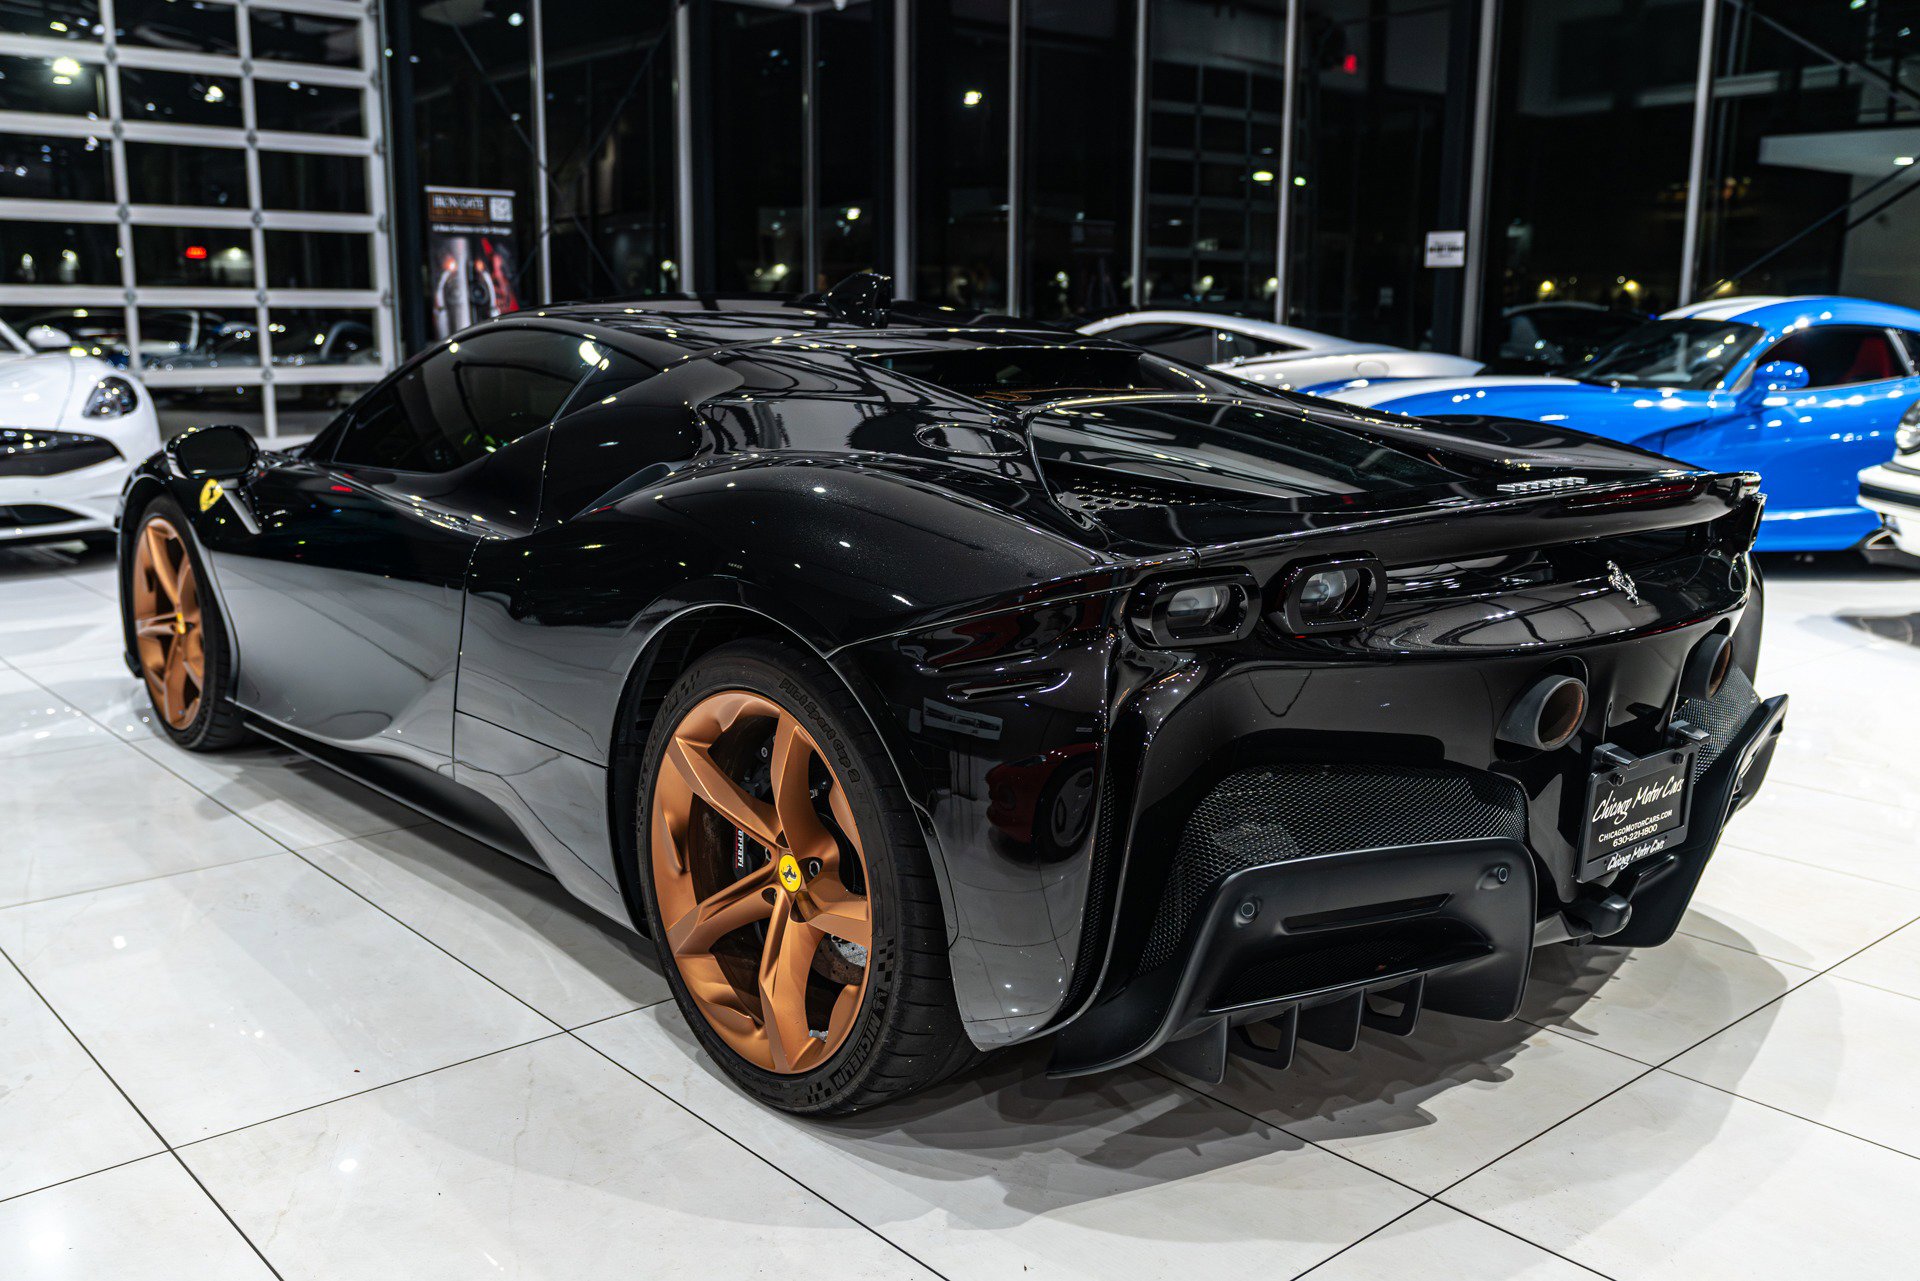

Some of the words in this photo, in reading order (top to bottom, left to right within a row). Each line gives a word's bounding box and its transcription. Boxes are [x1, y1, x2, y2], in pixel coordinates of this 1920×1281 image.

[779, 678, 808, 706] Pilot
[804, 701, 836, 740] Sport
[832, 739, 852, 768] Cup
[848, 768, 860, 783] 2
[1592, 790, 1633, 825] Chicago
[1632, 781, 1664, 808] Motor
[1662, 775, 1685, 798] Cars
[1607, 852, 1631, 869] Chicago
[1630, 844, 1651, 861] Motor
[1649, 839, 1665, 854] Cars
[1612, 823, 1658, 847] 630-221-1800
[833, 1011, 881, 1090] MICHELIN
